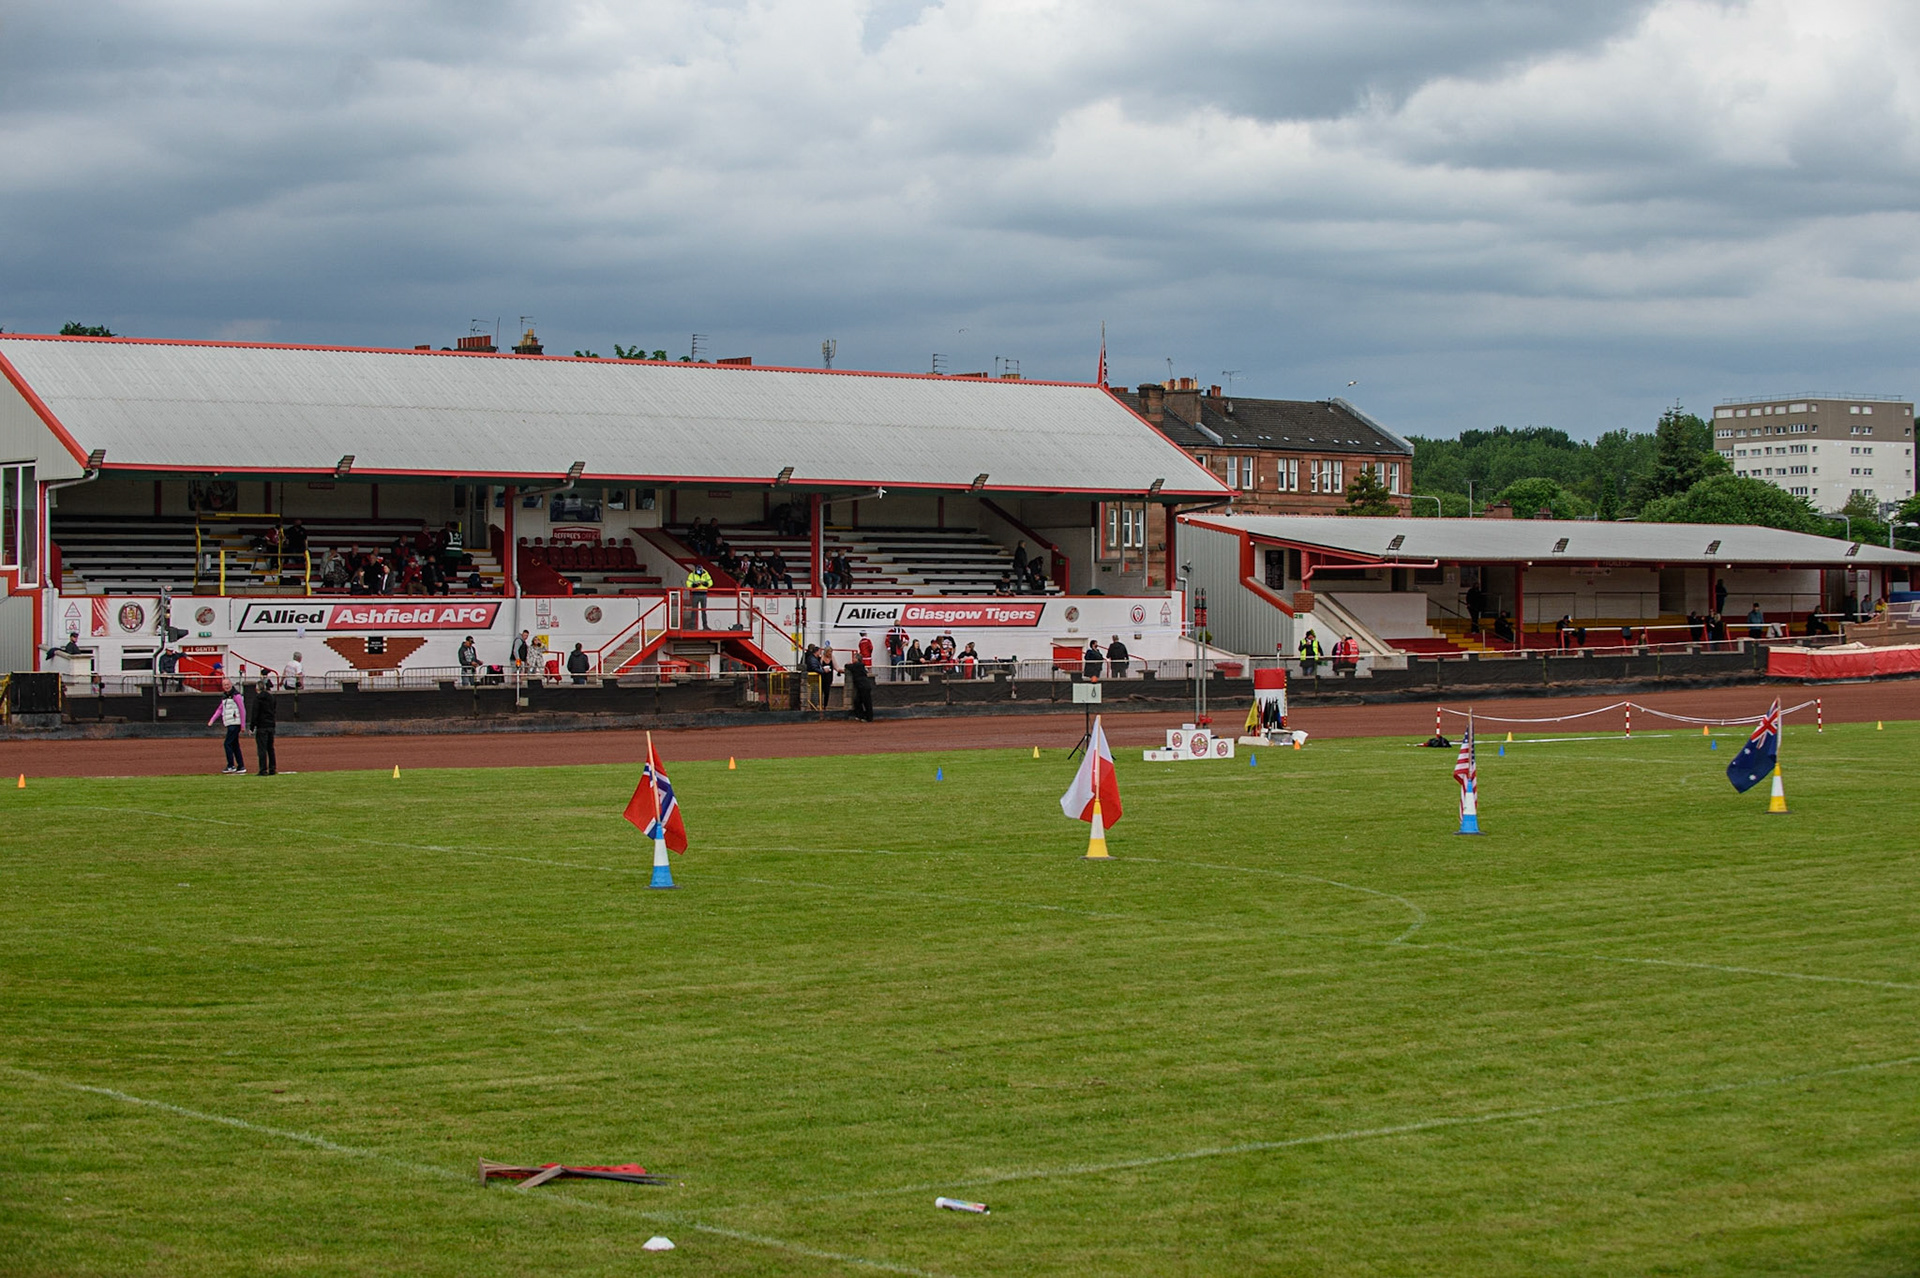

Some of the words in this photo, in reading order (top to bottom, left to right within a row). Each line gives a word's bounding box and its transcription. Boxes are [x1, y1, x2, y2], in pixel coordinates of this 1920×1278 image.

[254, 610, 325, 624] Allied
[334, 609, 434, 624] Ashfield
[437, 608, 487, 623] AFC
[847, 607, 898, 620] Allied
[906, 606, 982, 622] Glasgow
[985, 607, 1036, 622] Tigers
